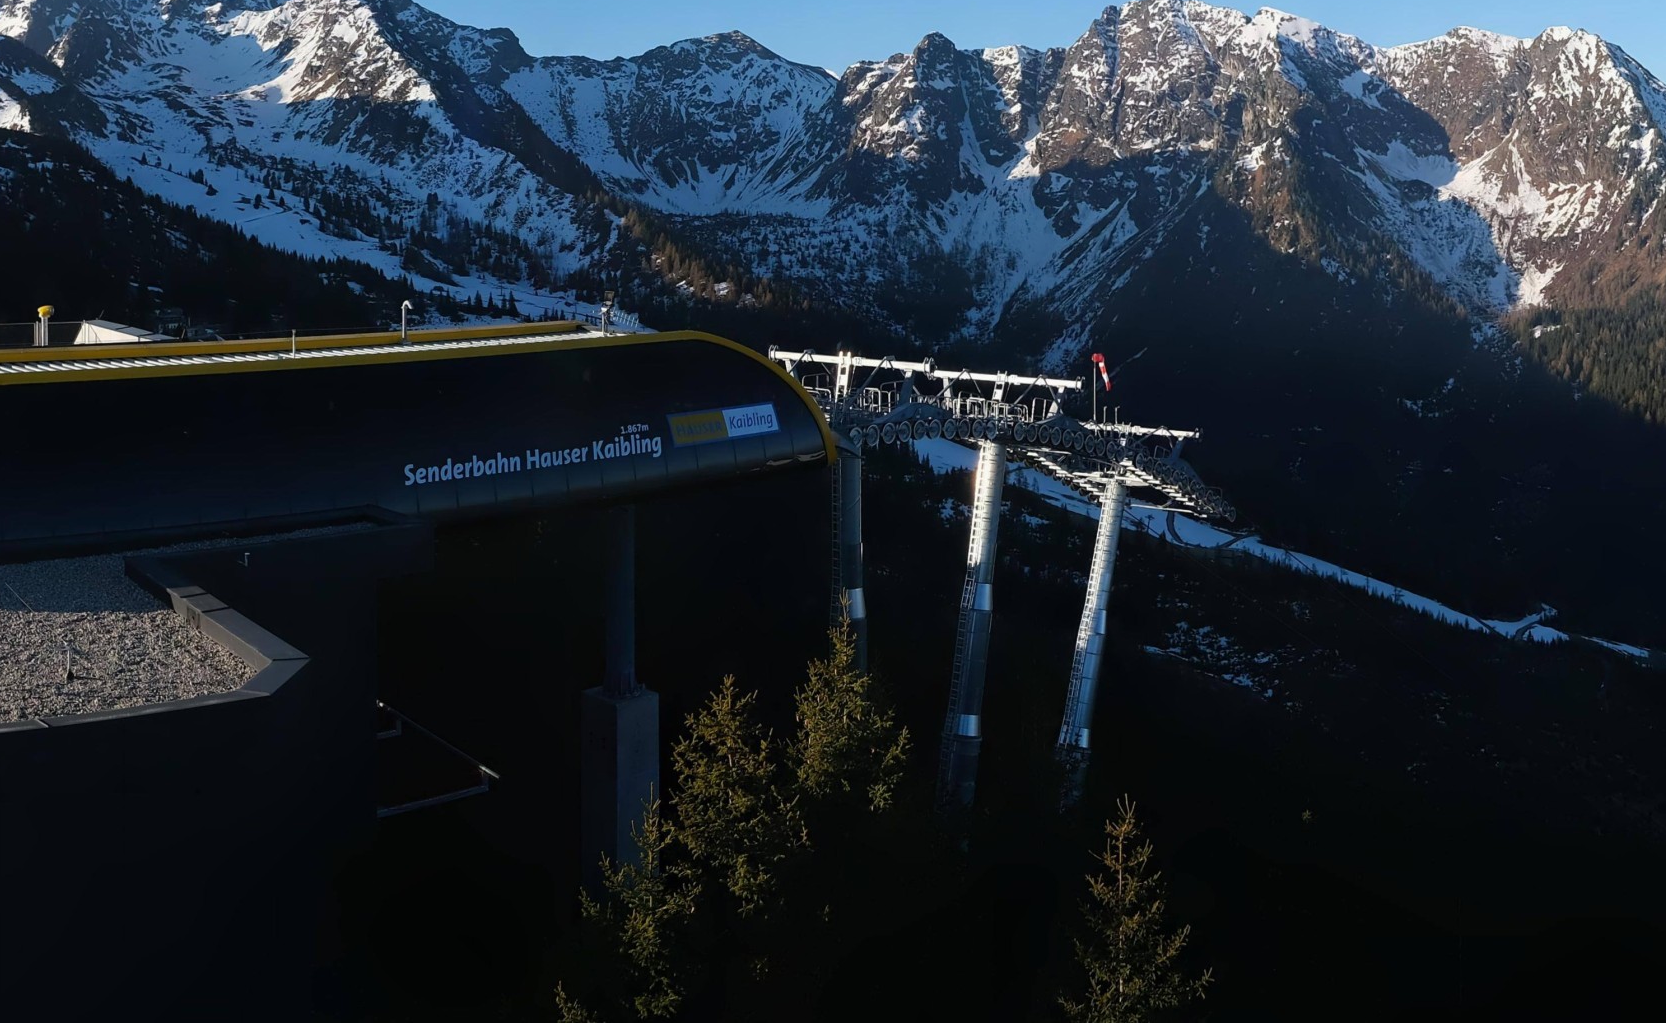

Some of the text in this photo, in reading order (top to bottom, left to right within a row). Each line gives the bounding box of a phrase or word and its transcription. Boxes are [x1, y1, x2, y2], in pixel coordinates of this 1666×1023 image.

[620, 423, 649, 434] 1.867m
[729, 412, 773, 430] Kaibling
[404, 434, 663, 486] Senderbahn Hauser Kaibling
